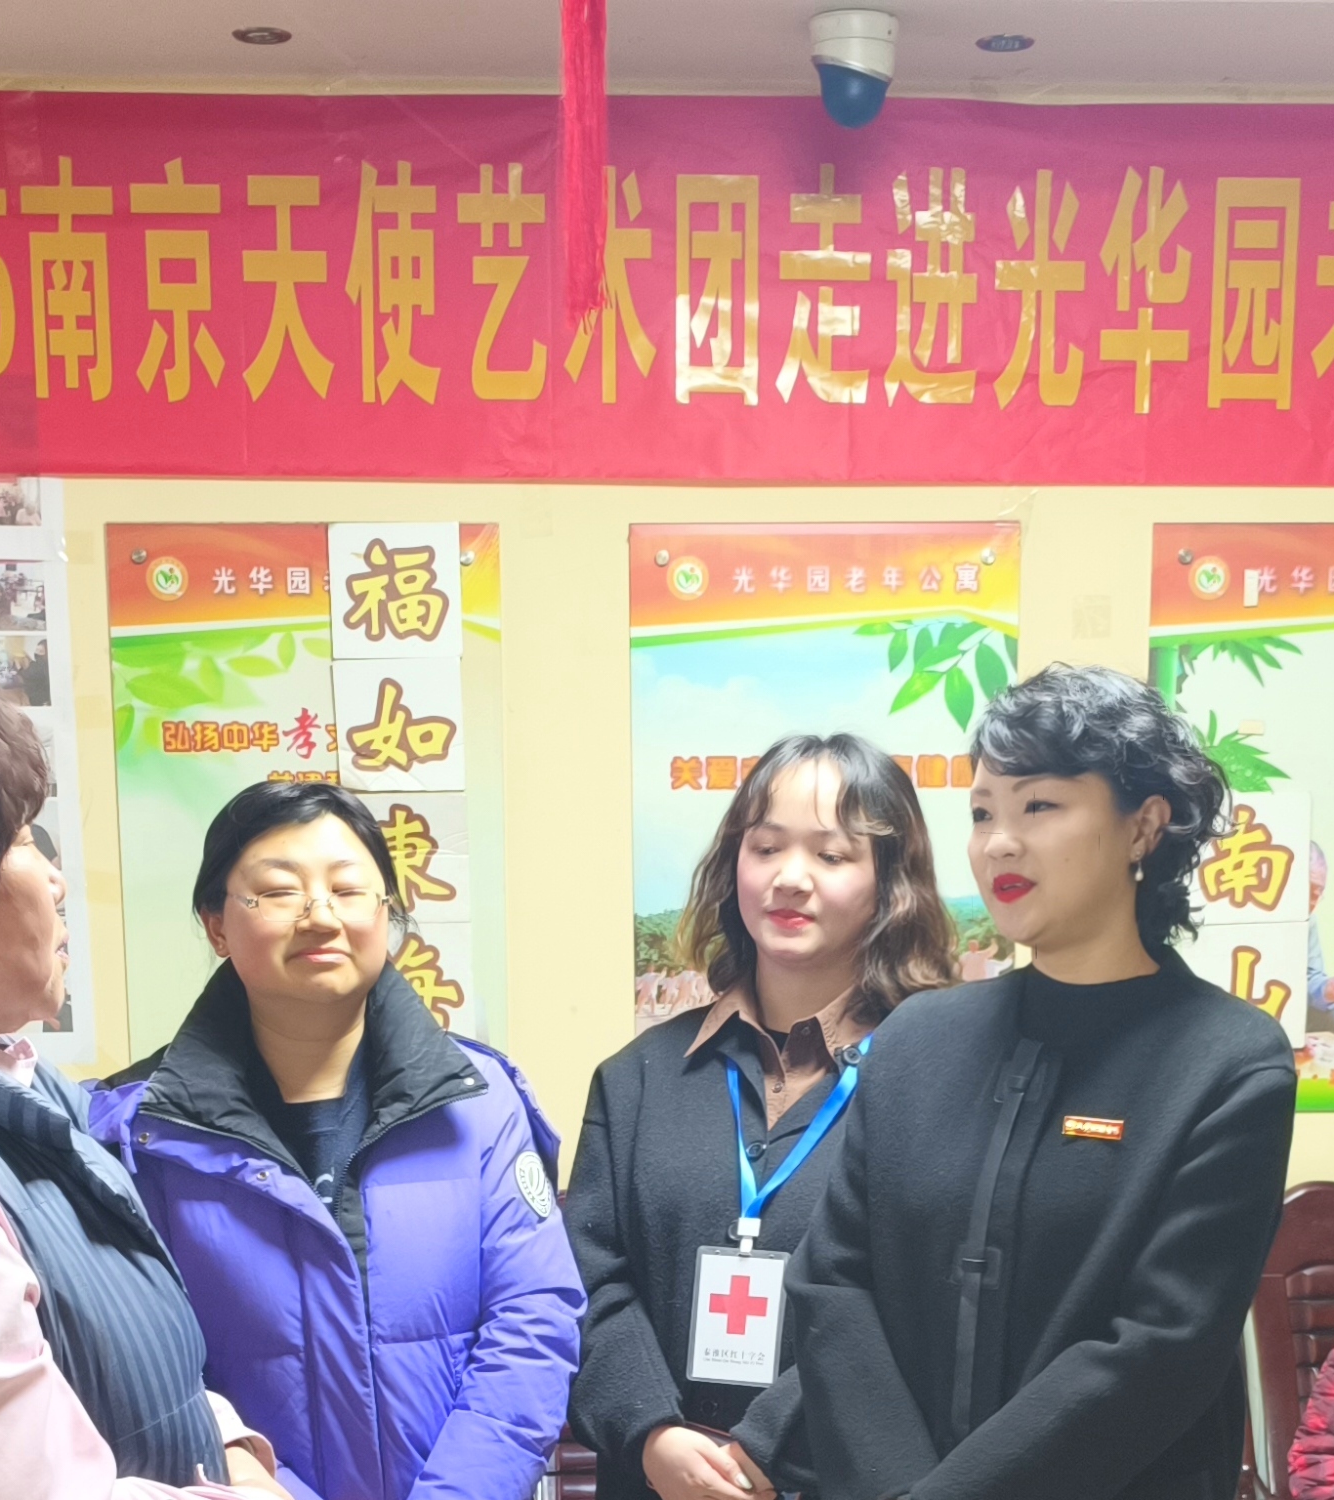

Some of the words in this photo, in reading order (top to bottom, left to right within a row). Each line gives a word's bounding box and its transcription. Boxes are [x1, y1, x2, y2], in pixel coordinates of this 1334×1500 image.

[212, 566, 332, 596] 光华园
[732, 563, 982, 594] 光华园老年公寓
